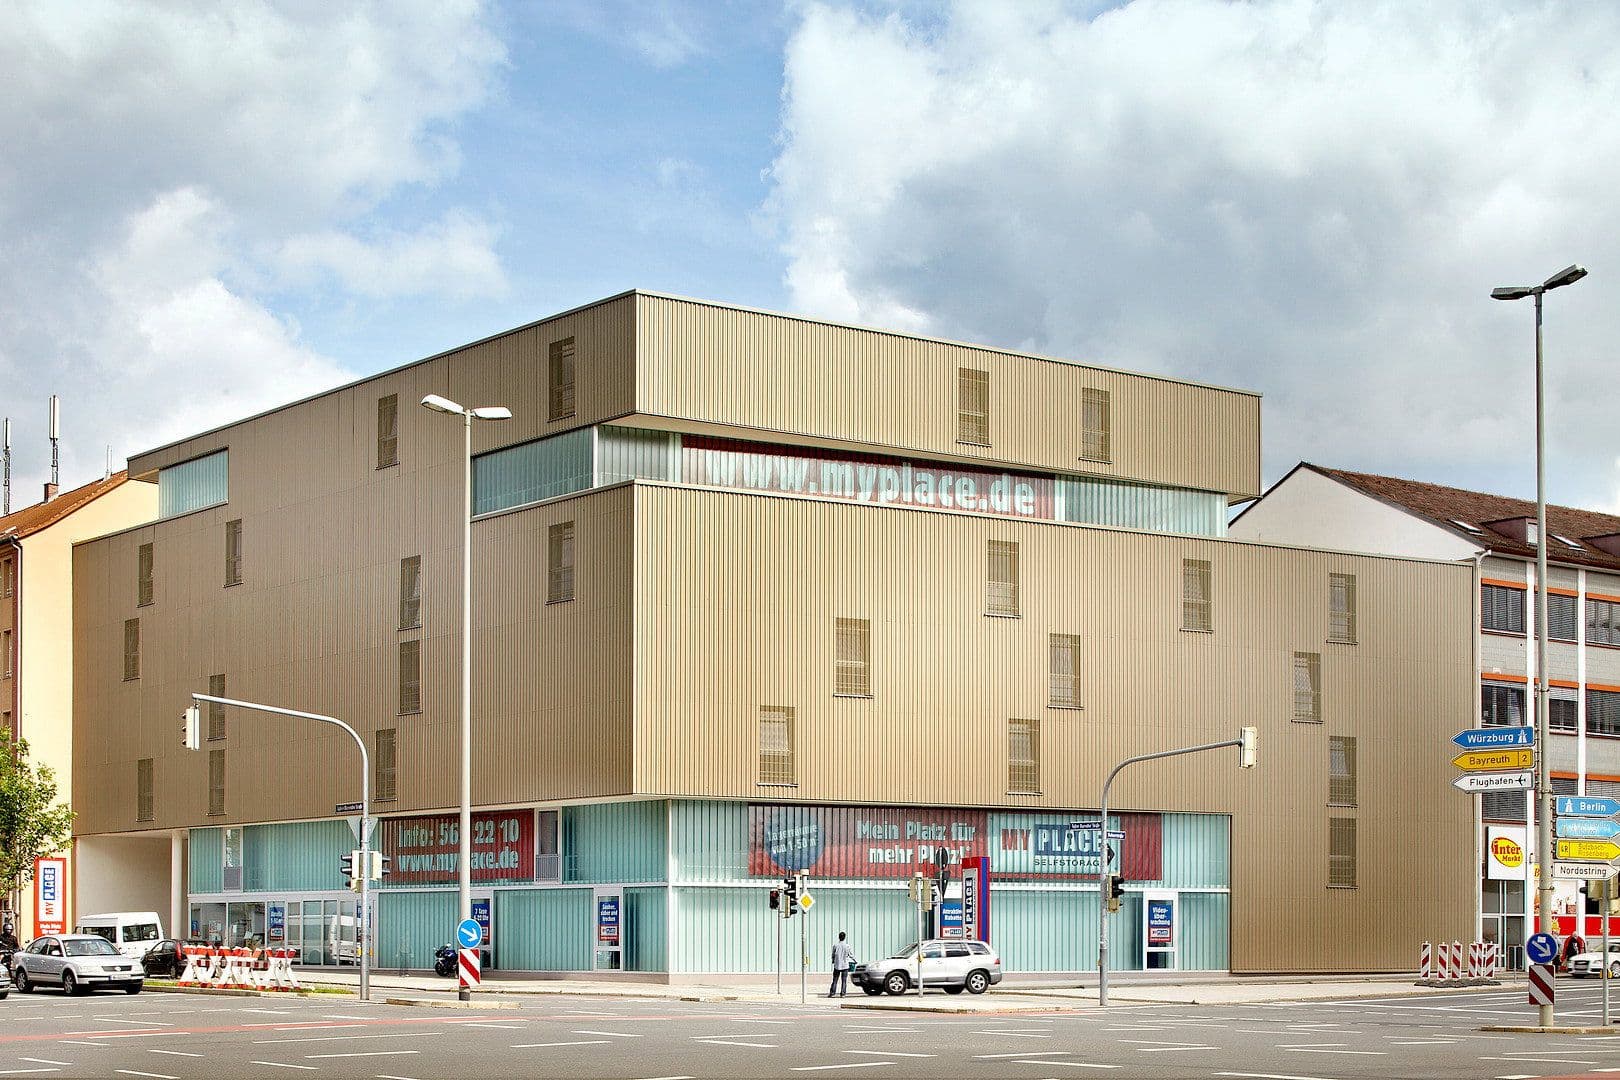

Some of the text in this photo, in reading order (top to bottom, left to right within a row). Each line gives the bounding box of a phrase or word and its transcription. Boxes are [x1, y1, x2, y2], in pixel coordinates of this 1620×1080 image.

[704, 449, 1035, 514] www.myplace.de
[1467, 733, 1514, 744] Würzburg
[1469, 754, 1528, 766] Bayreuth 2
[1469, 777, 1514, 787] Flughafen
[1580, 801, 1606, 813] Berlin
[399, 824, 434, 847] Info:
[474, 820, 495, 844] 22
[500, 818, 520, 843] 10
[857, 820, 976, 841] Mein Platz für
[1001, 829, 1031, 851] MY
[398, 845, 519, 873] www.myace.de
[869, 844, 914, 864] mehr
[1034, 858, 1100, 867] SELFSTORAG
[1560, 866, 1607, 877] Nordostring
[44, 868, 55, 900] PLACE
[45, 902, 54, 915] MY
[965, 879, 973, 922] PLACE
